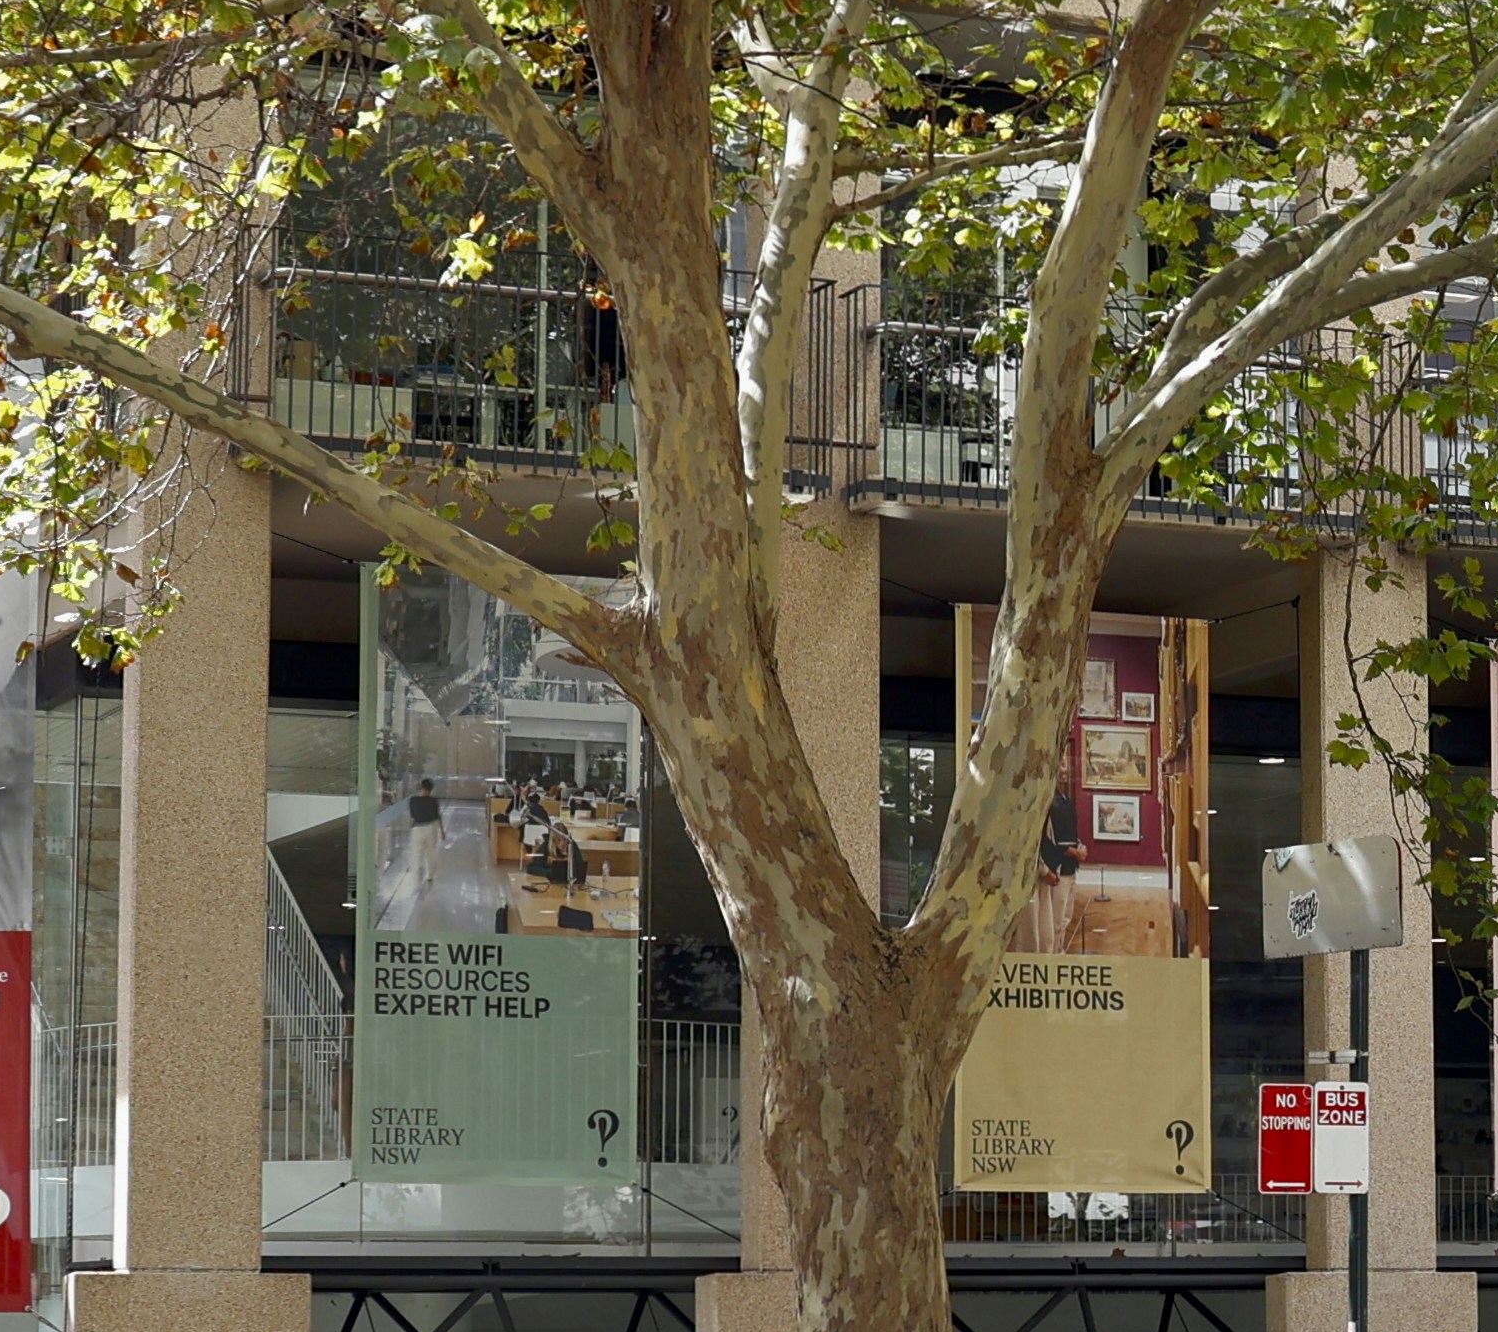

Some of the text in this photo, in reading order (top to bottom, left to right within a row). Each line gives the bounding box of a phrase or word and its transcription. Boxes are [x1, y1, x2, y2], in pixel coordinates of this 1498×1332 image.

[375, 942, 502, 966] FREE WIFI
[375, 968, 530, 993] RESOURCES
[994, 963, 1112, 986] VEN FREE
[374, 993, 550, 1019] EXPERT HELP
[987, 988, 1124, 1010] XHIBITIONS
[1276, 1093, 1297, 1108] NO
[1325, 1092, 1359, 1107] BUS
[372, 1108, 438, 1126] STATE
[1262, 1116, 1311, 1130] STOPPING
[1319, 1110, 1364, 1124] ZONE
[971, 1119, 1031, 1136] STATE
[372, 1127, 464, 1146] LIBRARY
[972, 1138, 1055, 1155] LIBRARY
[371, 1147, 421, 1164] NSW
[972, 1157, 1016, 1174] NSW
